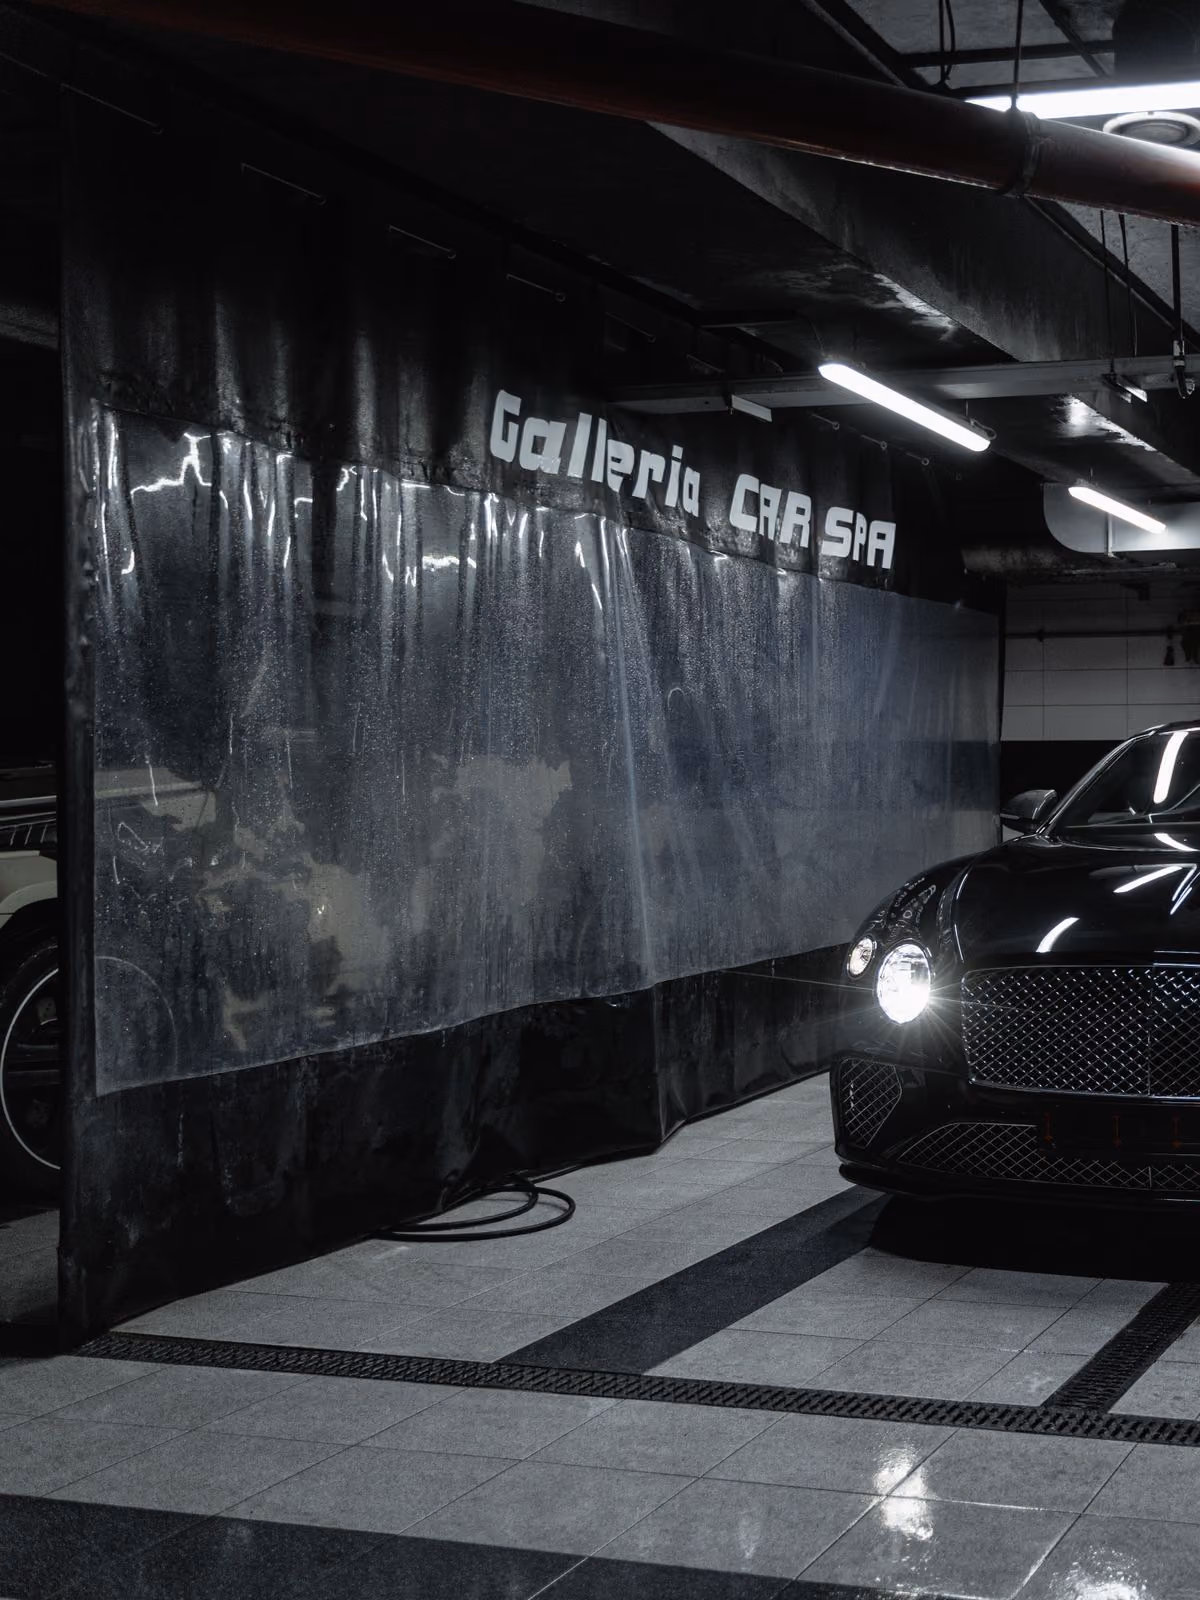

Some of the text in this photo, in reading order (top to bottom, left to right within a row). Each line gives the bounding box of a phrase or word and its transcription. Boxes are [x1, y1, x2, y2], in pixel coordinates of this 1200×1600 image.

[490, 389, 897, 569] Galleria CAR SPA
